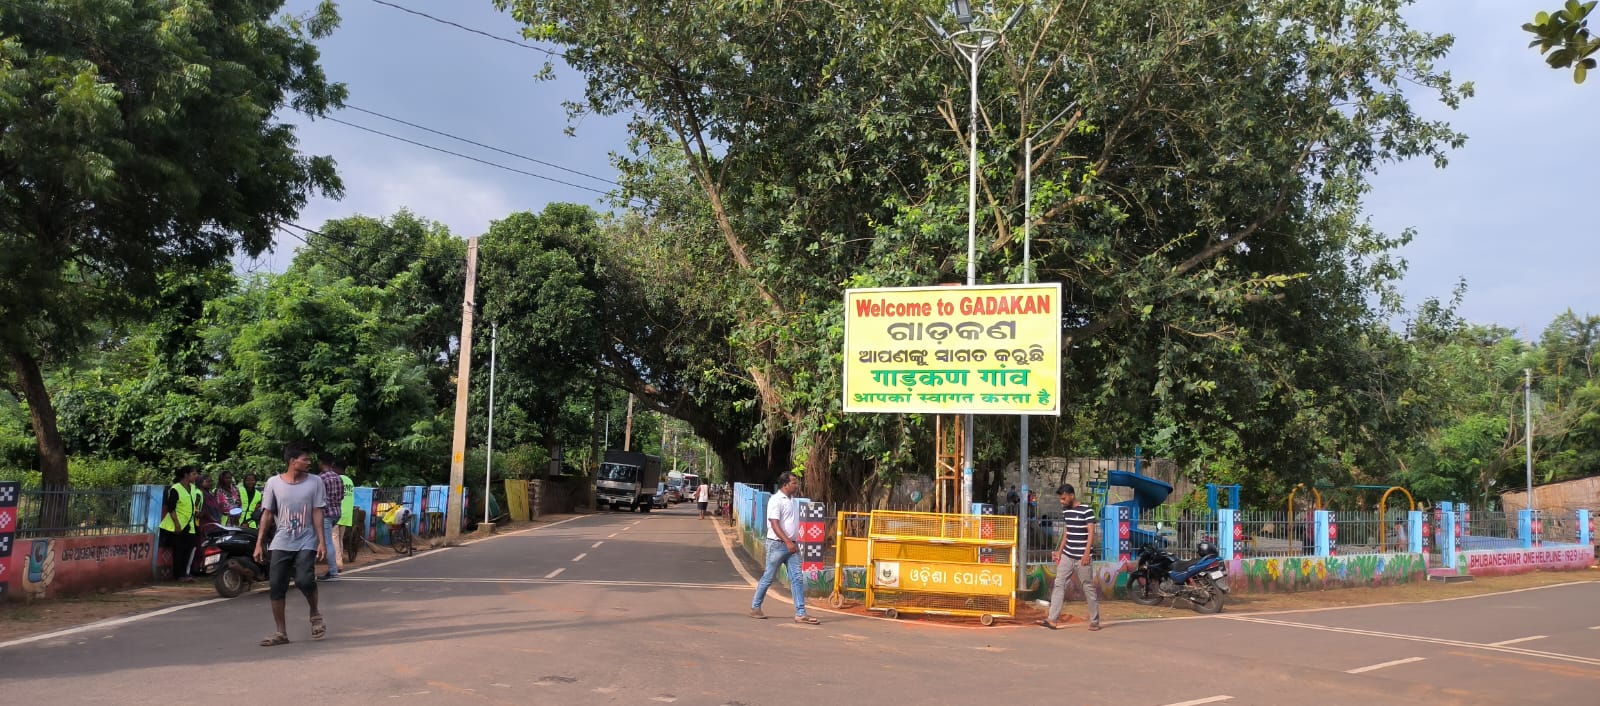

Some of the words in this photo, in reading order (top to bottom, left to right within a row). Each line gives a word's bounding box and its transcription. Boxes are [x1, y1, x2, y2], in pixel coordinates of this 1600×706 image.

[856, 298, 932, 318] Welcome
[937, 298, 955, 317] to
[959, 294, 1050, 316] GADAKAN
[887, 320, 1016, 345] ଗାଡ଼କଣ
[858, 348, 929, 366] ଆପଣଙ୍କୁ
[994, 344, 1045, 366] କରୁଛି
[870, 369, 970, 391] गाड़कण
[977, 363, 1031, 388] गांव
[916, 392, 975, 405] स्वागत
[981, 392, 1032, 405] करता
[1036, 388, 1051, 406] है
[128, 542, 150, 560] 1929
[1470, 552, 1521, 568] BHUBANESWAR
[1523, 551, 1535, 564] ONE
[1535, 550, 1561, 563] HELPLINE
[1565, 549, 1577, 561] 1929
[910, 566, 947, 587] ଓଡ଼ିଶା
